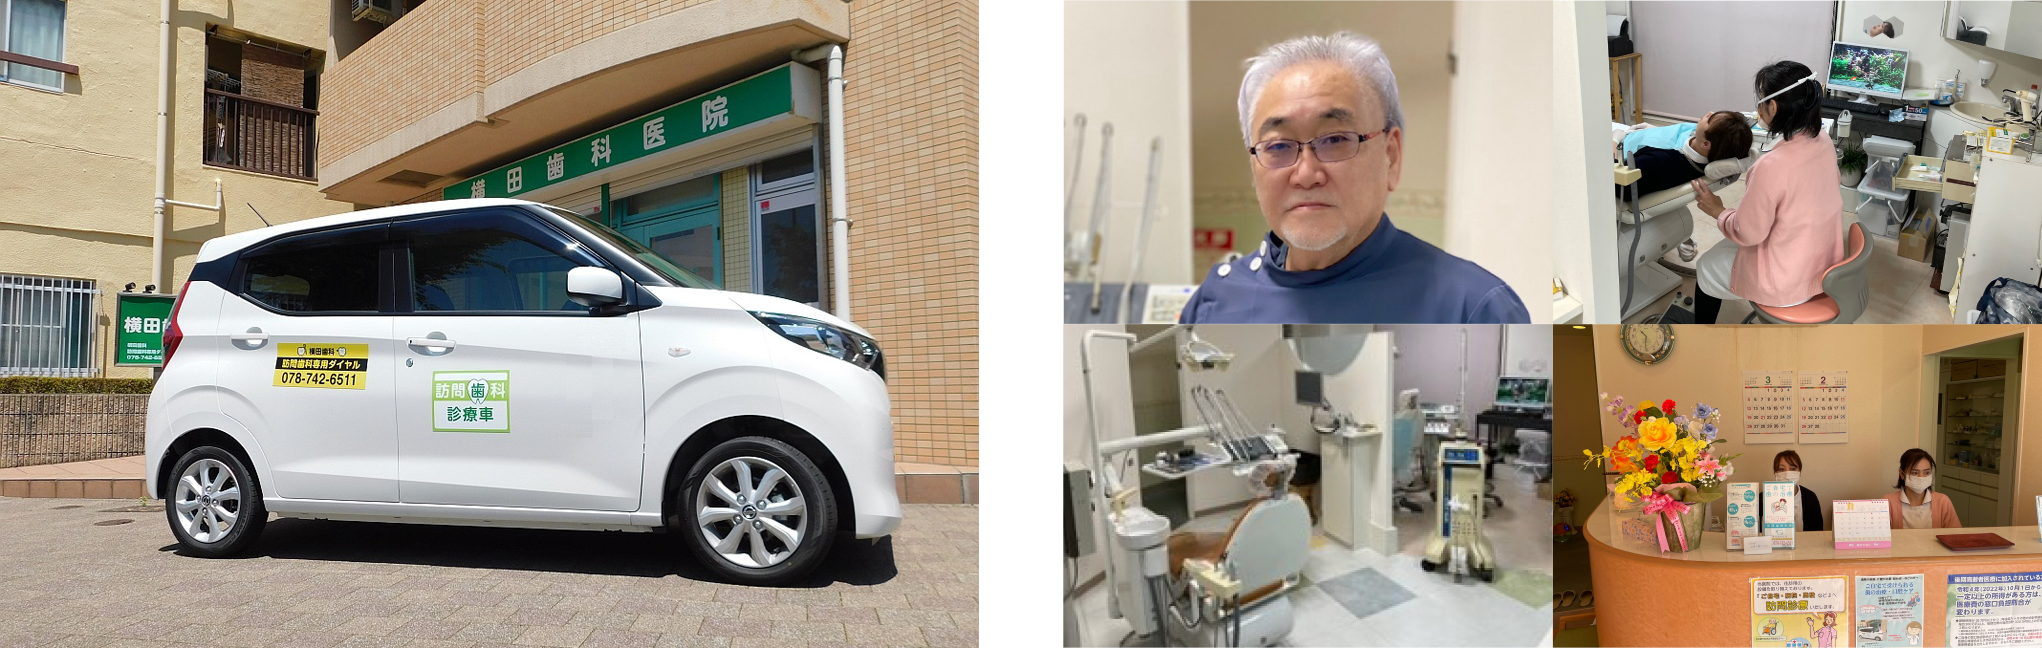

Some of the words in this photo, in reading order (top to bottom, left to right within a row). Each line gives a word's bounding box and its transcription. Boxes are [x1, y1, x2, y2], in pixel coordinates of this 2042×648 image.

[470, 95, 730, 200] 横田歯科医院
[309, 347, 335, 356] 横田歯科
[281, 359, 361, 370] 訪問歯科専用ダイヤル
[281, 372, 356, 386] 078-742-6511
[1765, 376, 1771, 384] 3
[1820, 376, 1826, 384] 2
[435, 382, 506, 399] 訪問歯科
[446, 406, 494, 422] 診療車
[1954, 574, 2042, 583] 後期高齢者医療に加入されている
